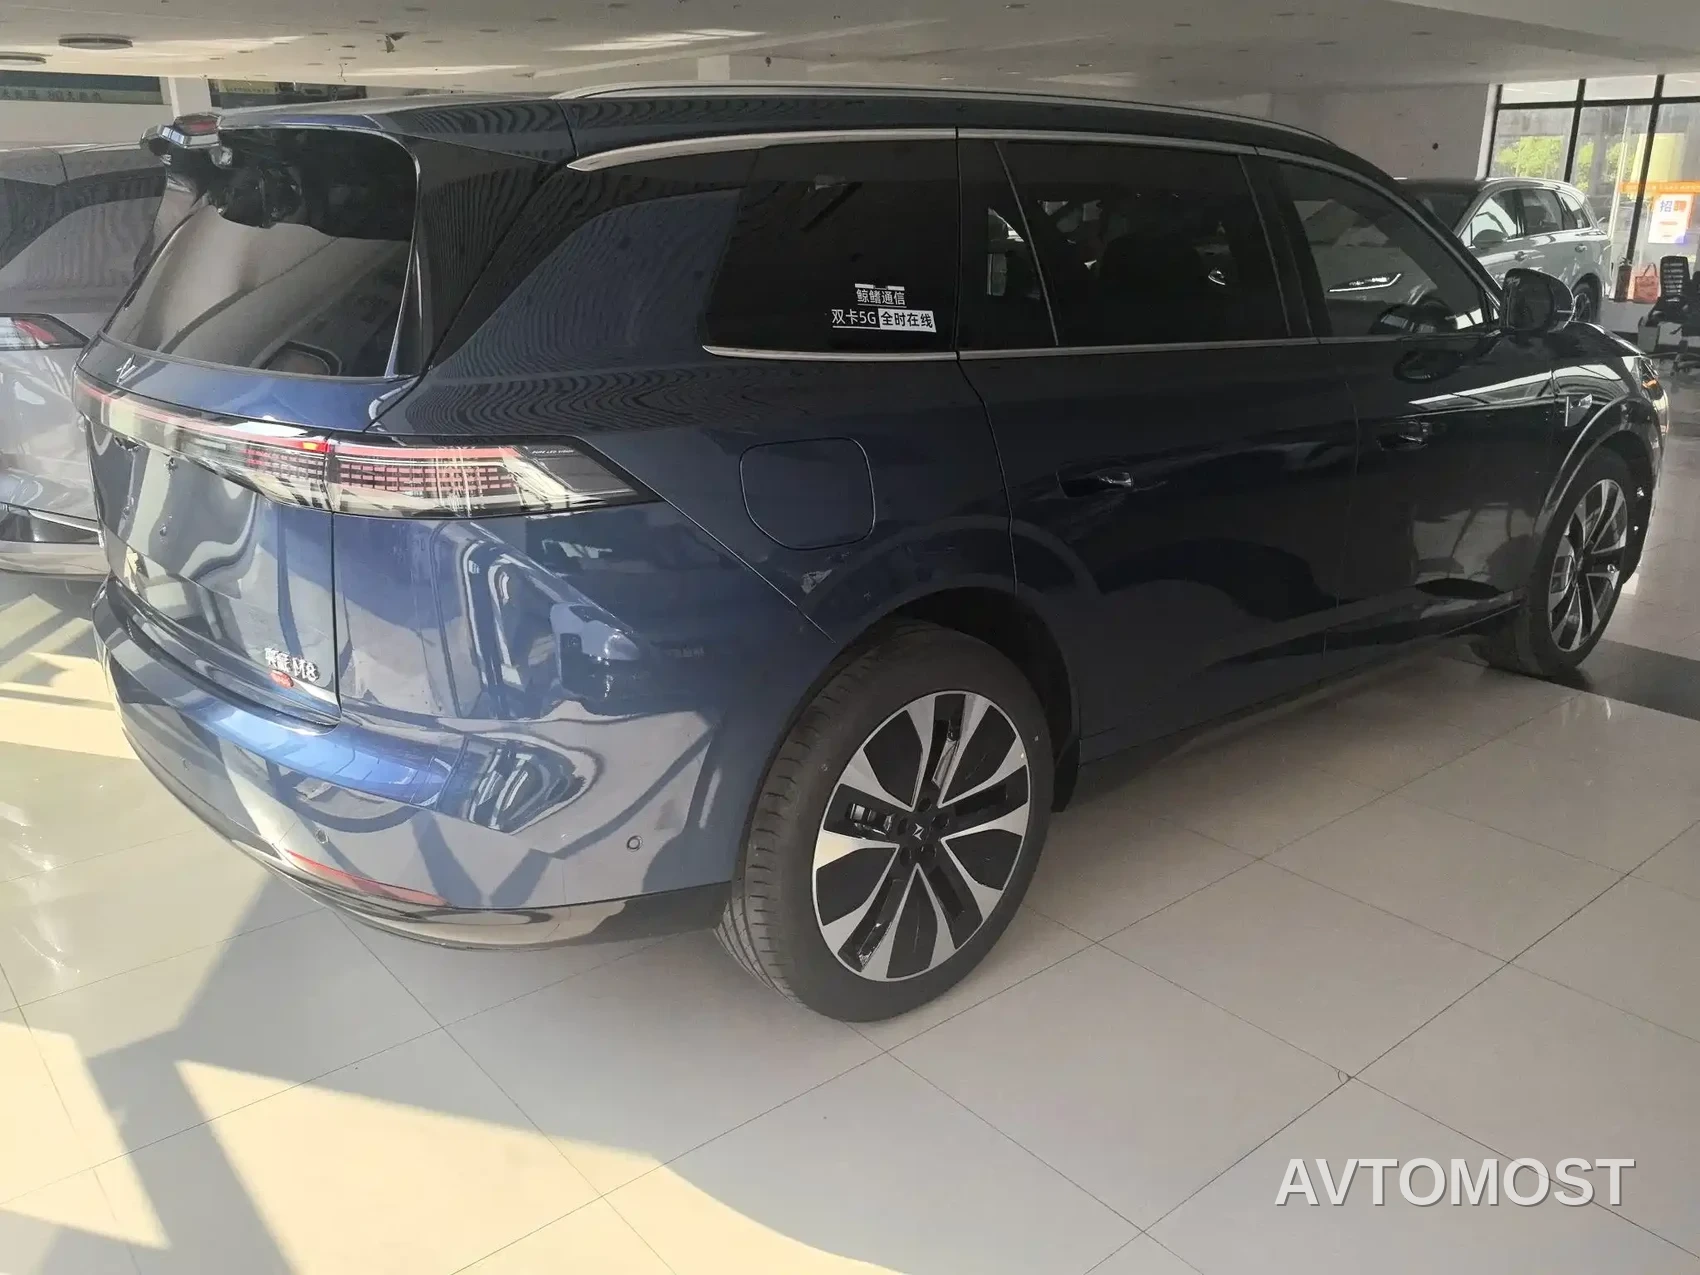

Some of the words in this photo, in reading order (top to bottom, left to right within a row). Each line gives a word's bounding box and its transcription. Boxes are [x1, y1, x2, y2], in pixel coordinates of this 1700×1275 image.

[856, 288, 906, 306] 鲸鳍通信
[831, 308, 877, 325] 双卡5G
[880, 310, 934, 329] 全时在线
